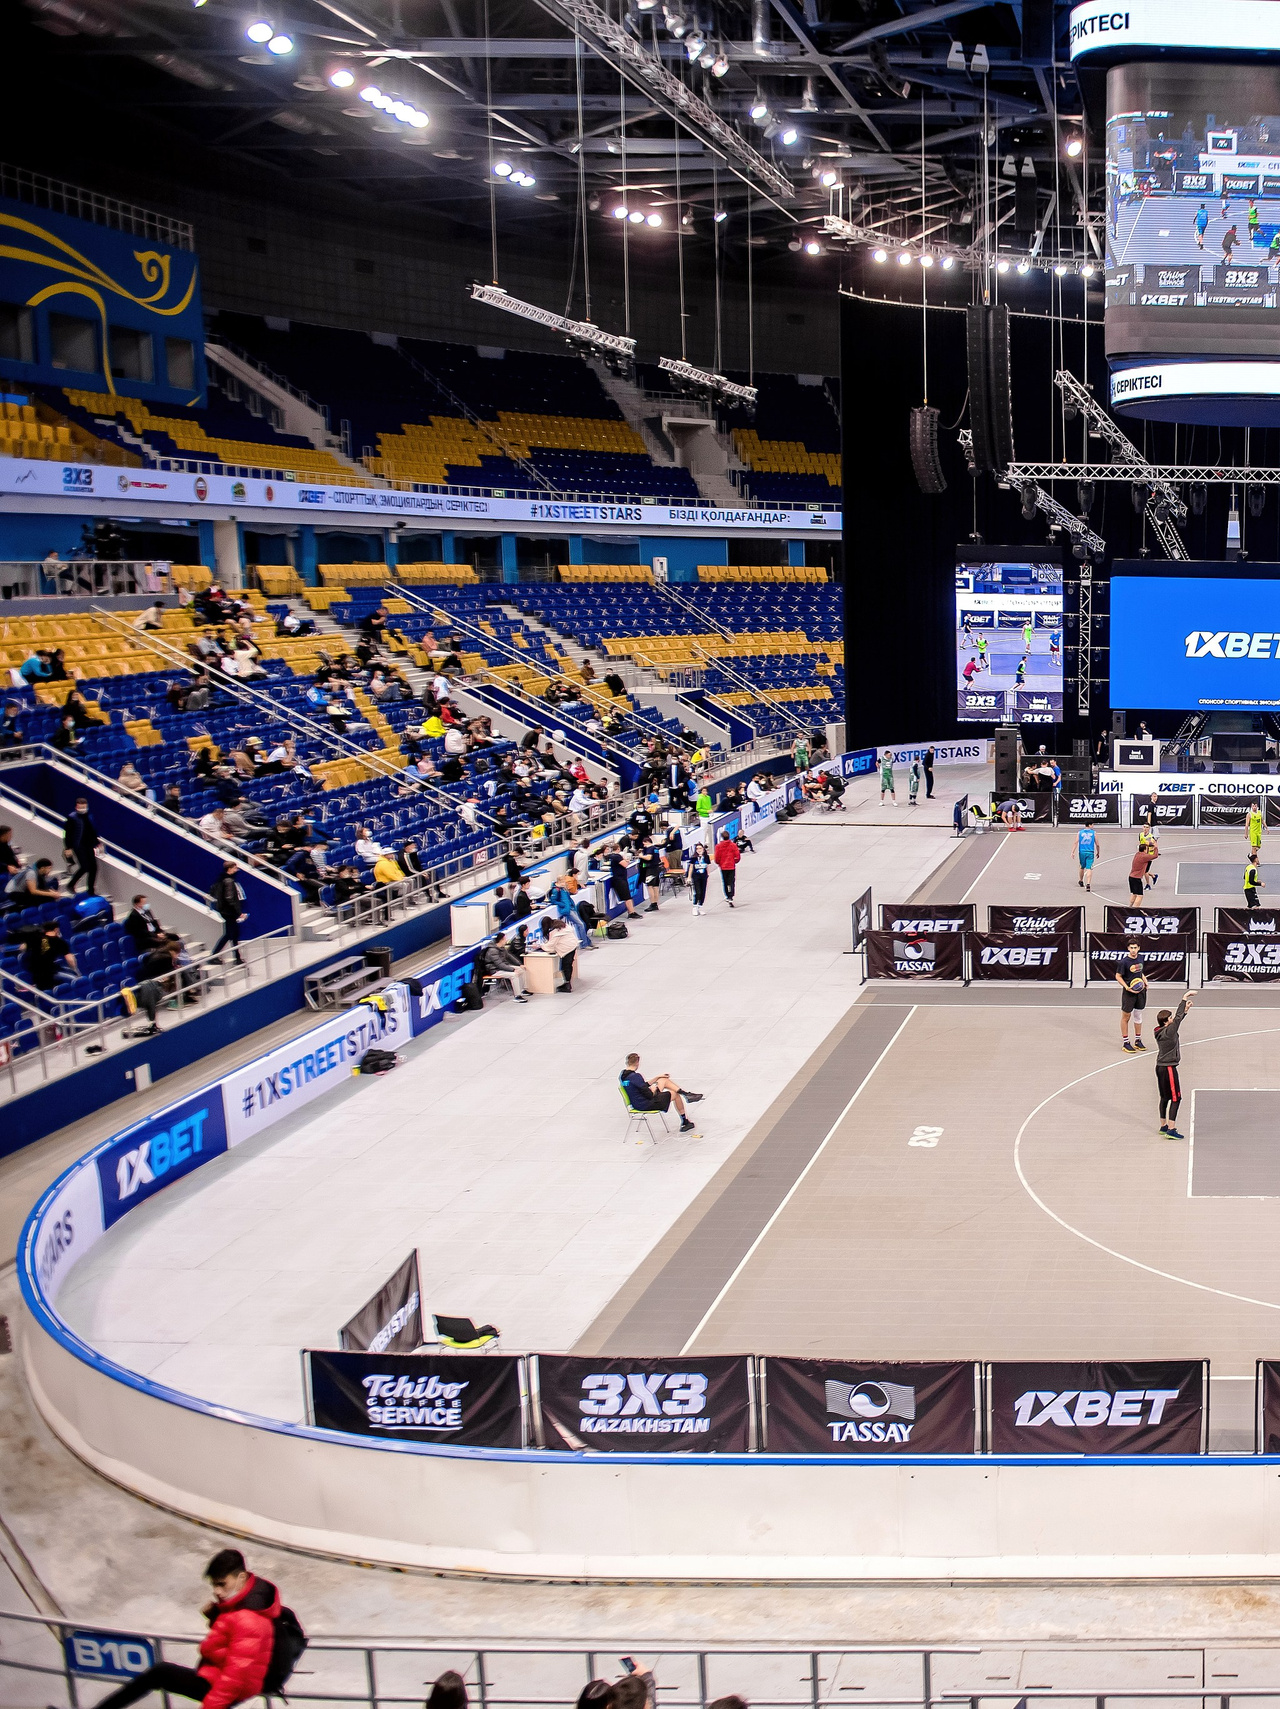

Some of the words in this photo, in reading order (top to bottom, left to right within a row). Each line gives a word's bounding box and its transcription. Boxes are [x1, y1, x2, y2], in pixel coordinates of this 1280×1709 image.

[1116, 374, 1162, 394] СЕРІКТЕСІ
[530, 506, 642, 520] #1XSTREETSTARS
[669, 509, 698, 520] БІЗДІ
[966, 696, 997, 706] 3X3
[844, 754, 872, 775] 1XBET
[1158, 783, 1196, 792] 1XBET
[1208, 784, 1274, 794] СПОНСОР
[1070, 799, 1108, 812] 3X3
[1012, 916, 1060, 928] Tchibo
[1124, 916, 1180, 934] 3X3
[894, 960, 936, 972] TASSAY
[980, 946, 1058, 966] 1XBET
[419, 962, 476, 1019] 1XBET
[242, 1006, 398, 1119] #1XSTREETSTARS
[116, 1108, 210, 1200] 1XBET
[362, 1374, 470, 1400] Tchibo
[578, 1372, 710, 1416] 3X3
[366, 1398, 462, 1408] COFFEE
[1014, 1388, 1180, 1428] 1XBET
[368, 1406, 463, 1426] SERVICE
[578, 1416, 711, 1434] KAZAKHSTAN
[826, 1420, 916, 1444] TASSAY
[72, 1638, 150, 1673] B10
